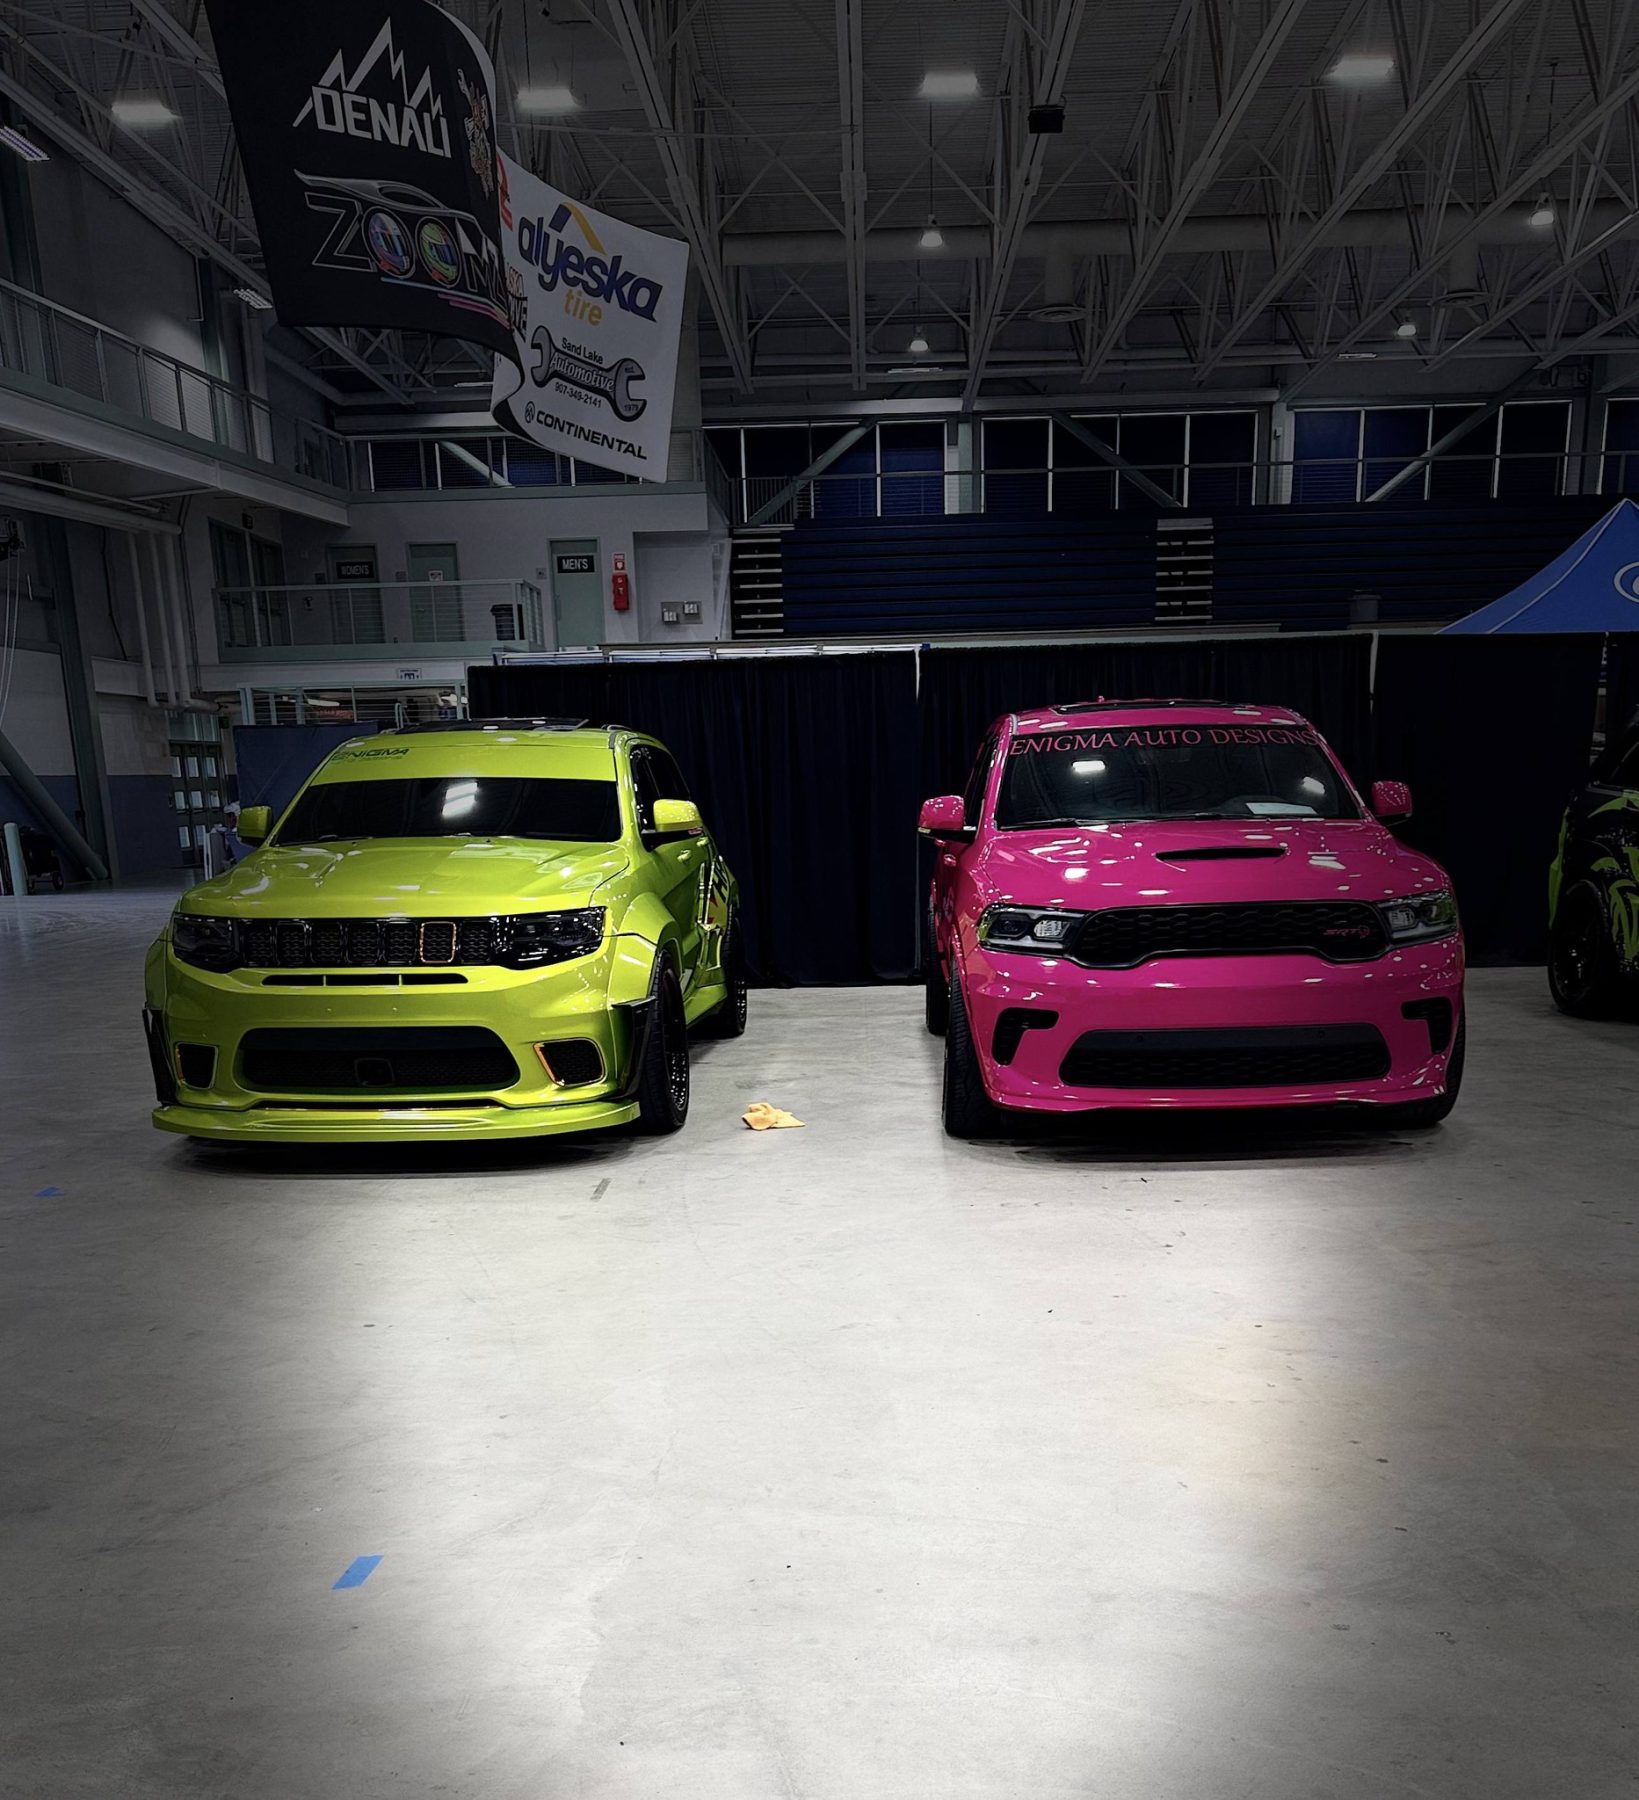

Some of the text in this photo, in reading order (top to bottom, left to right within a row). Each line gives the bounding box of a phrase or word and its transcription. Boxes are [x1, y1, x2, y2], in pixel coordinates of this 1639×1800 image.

[311, 85, 452, 159] DENALI
[518, 216, 663, 323] alyeska
[564, 289, 603, 326] tire
[561, 337, 604, 364] Sand Lake
[550, 354, 615, 392] Automotive
[536, 410, 647, 460] CONTINENTAL
[562, 558, 589, 570] MEN'S
[331, 748, 410, 761] ENIGMA
[1009, 728, 1320, 756] ENIGMA AUTO DESIGNS
